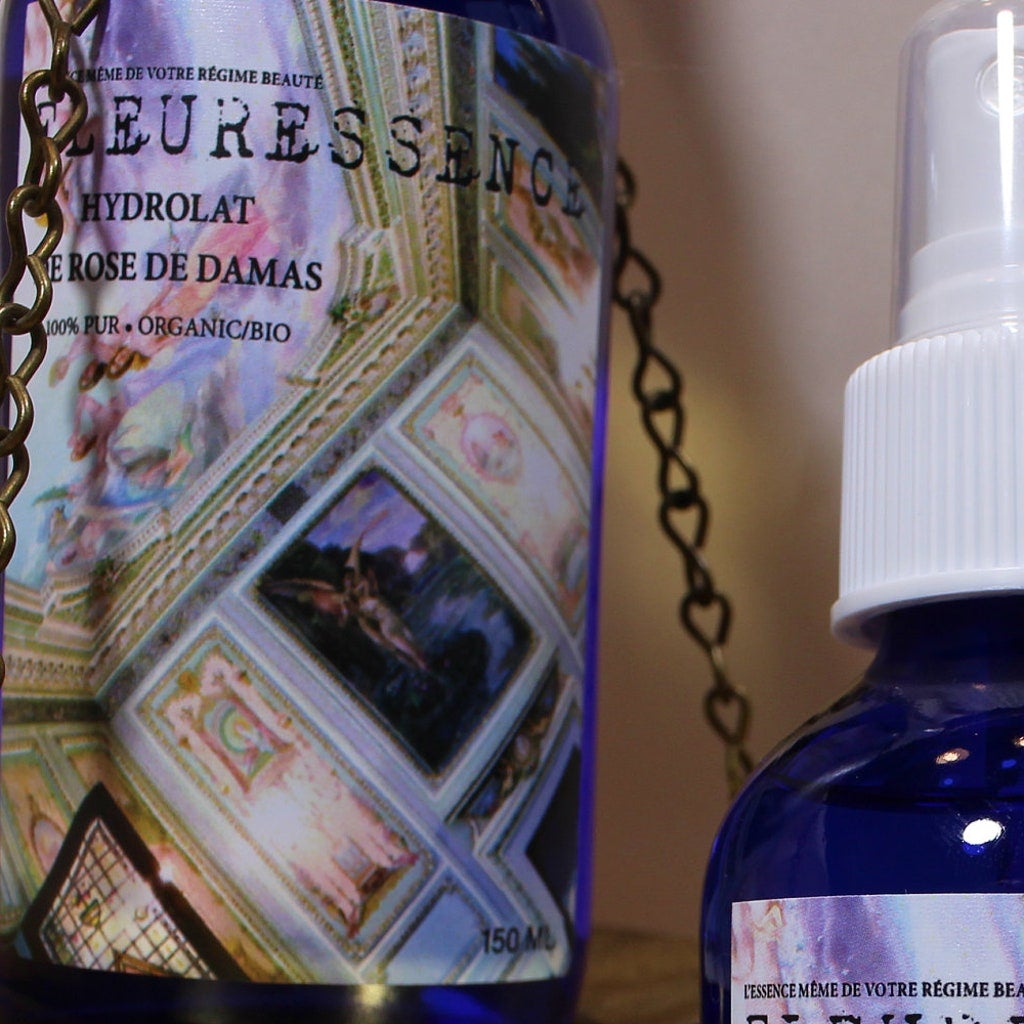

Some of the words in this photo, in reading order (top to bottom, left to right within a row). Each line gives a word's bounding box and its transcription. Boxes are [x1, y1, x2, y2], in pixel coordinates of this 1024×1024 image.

[126, 67, 144, 80] DE
[147, 66, 194, 81] VOTRE
[198, 66, 258, 84] RÉGIME
[261, 71, 324, 90] BEAUTÉ
[80, 192, 255, 224] HYDROLAT
[68, 251, 137, 282] ROSE
[144, 252, 188, 282] DE
[196, 256, 322, 291] DAMAS
[46, 316, 79, 336] 100%
[84, 315, 119, 334] PUR
[138, 316, 290, 342] ORGANIC/BIO
[481, 927, 520, 954] 150
[744, 983, 796, 999] L'ESSENCE
[798, 980, 838, 998] MÊME
[841, 982, 862, 997] DE
[865, 982, 918, 998] VOTRE
[922, 979, 989, 997] RÉGIME
